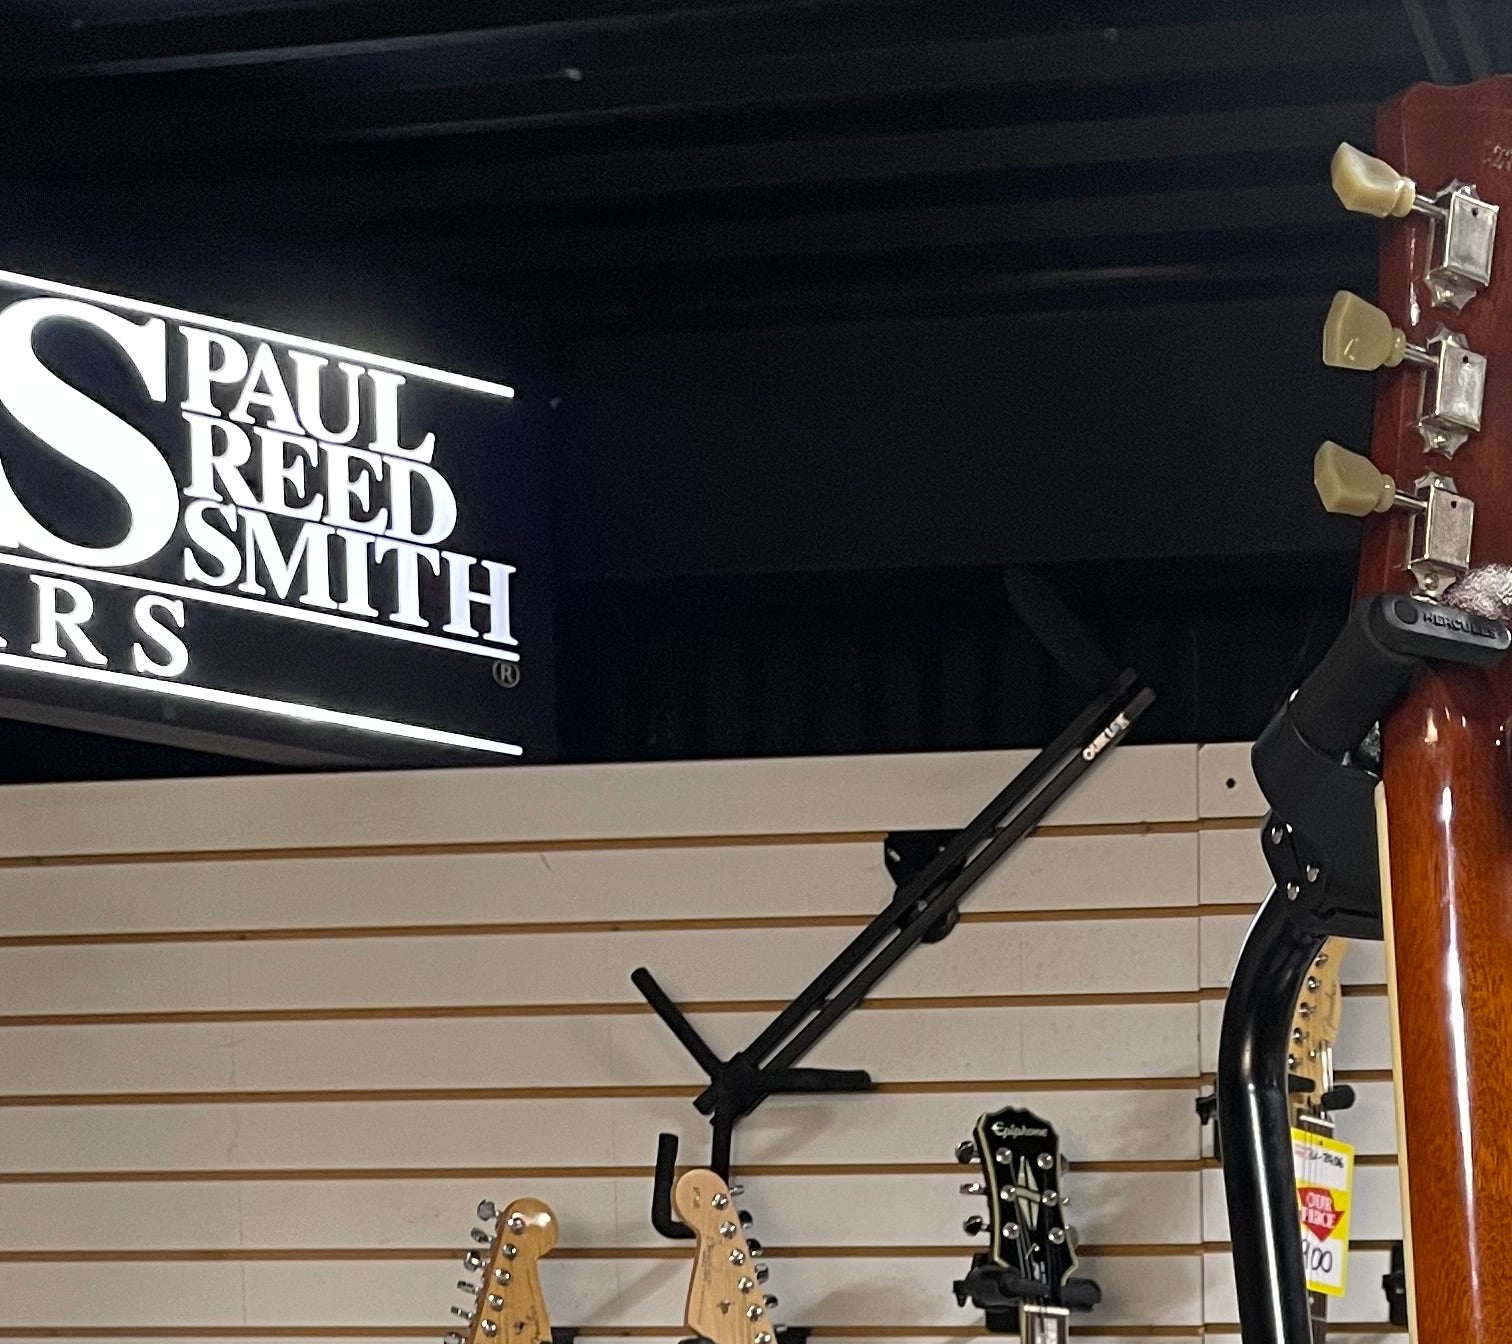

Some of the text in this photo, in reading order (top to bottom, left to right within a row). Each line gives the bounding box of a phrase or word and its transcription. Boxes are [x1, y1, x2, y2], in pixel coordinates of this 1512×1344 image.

[178, 326, 436, 465] PAUL
[180, 411, 458, 546] REED
[183, 499, 519, 646] SMITH
[0, 574, 189, 676] RS
[1422, 612, 1497, 639] HERCULES
[991, 1121, 1048, 1139] Epiphone
[1302, 1208, 1336, 1228] PRICE
[1306, 1192, 1332, 1210] OUR
